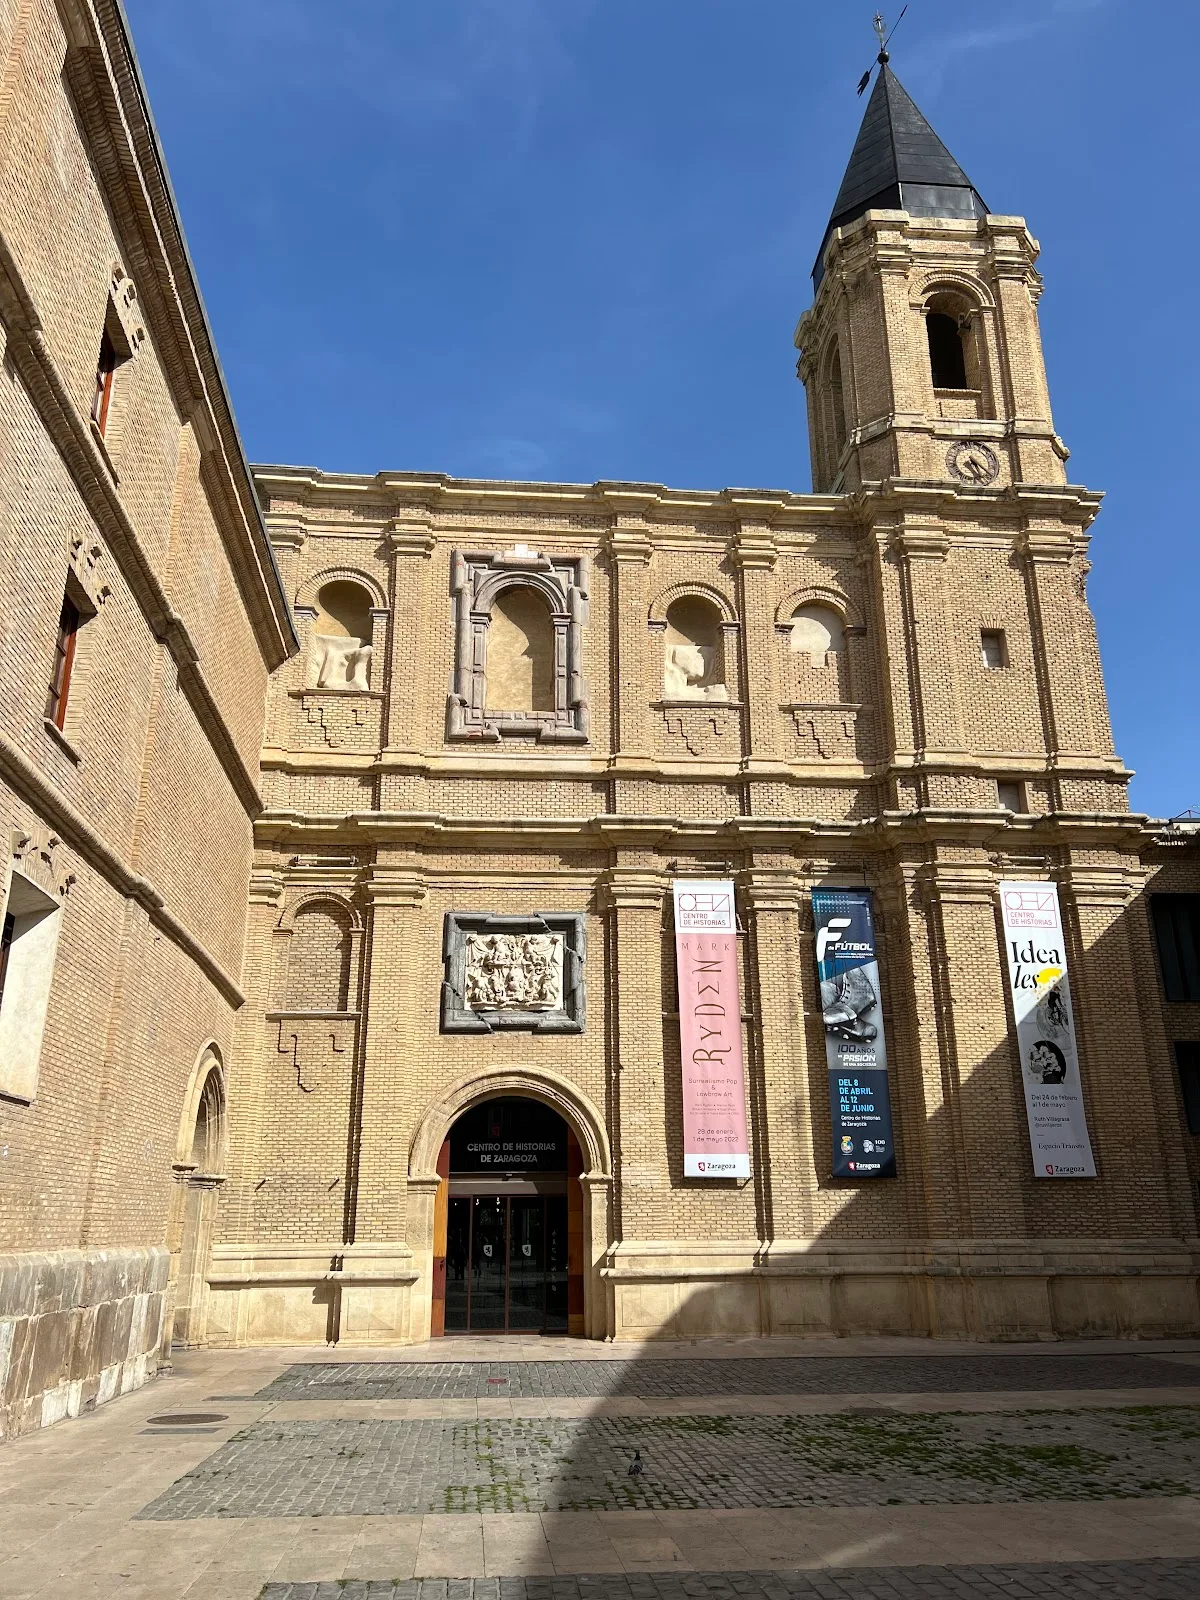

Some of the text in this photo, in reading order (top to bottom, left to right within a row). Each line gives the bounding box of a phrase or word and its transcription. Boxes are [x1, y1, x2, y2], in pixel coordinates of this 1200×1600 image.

[681, 943, 730, 951] MARK
[835, 941, 873, 951] FÚTBOL
[1010, 940, 1062, 964] Idea
[1014, 965, 1040, 989] les
[837, 1044, 876, 1054] 100 AÑOS
[842, 1052, 876, 1062] PASIÓN
[838, 1079, 859, 1087] DEL 8
[839, 1087, 874, 1095] DE ABRIL
[840, 1096, 858, 1104] AL 12
[467, 1142, 556, 1152] CENTRO DE HISTORIAS
[1038, 1142, 1060, 1150] Espacio
[480, 1154, 538, 1163] DE ZARAGOZA
[707, 1162, 736, 1171] Zaragoza
[856, 1162, 881, 1170] Zaragoza
[1054, 1165, 1085, 1174] Zaragoza
